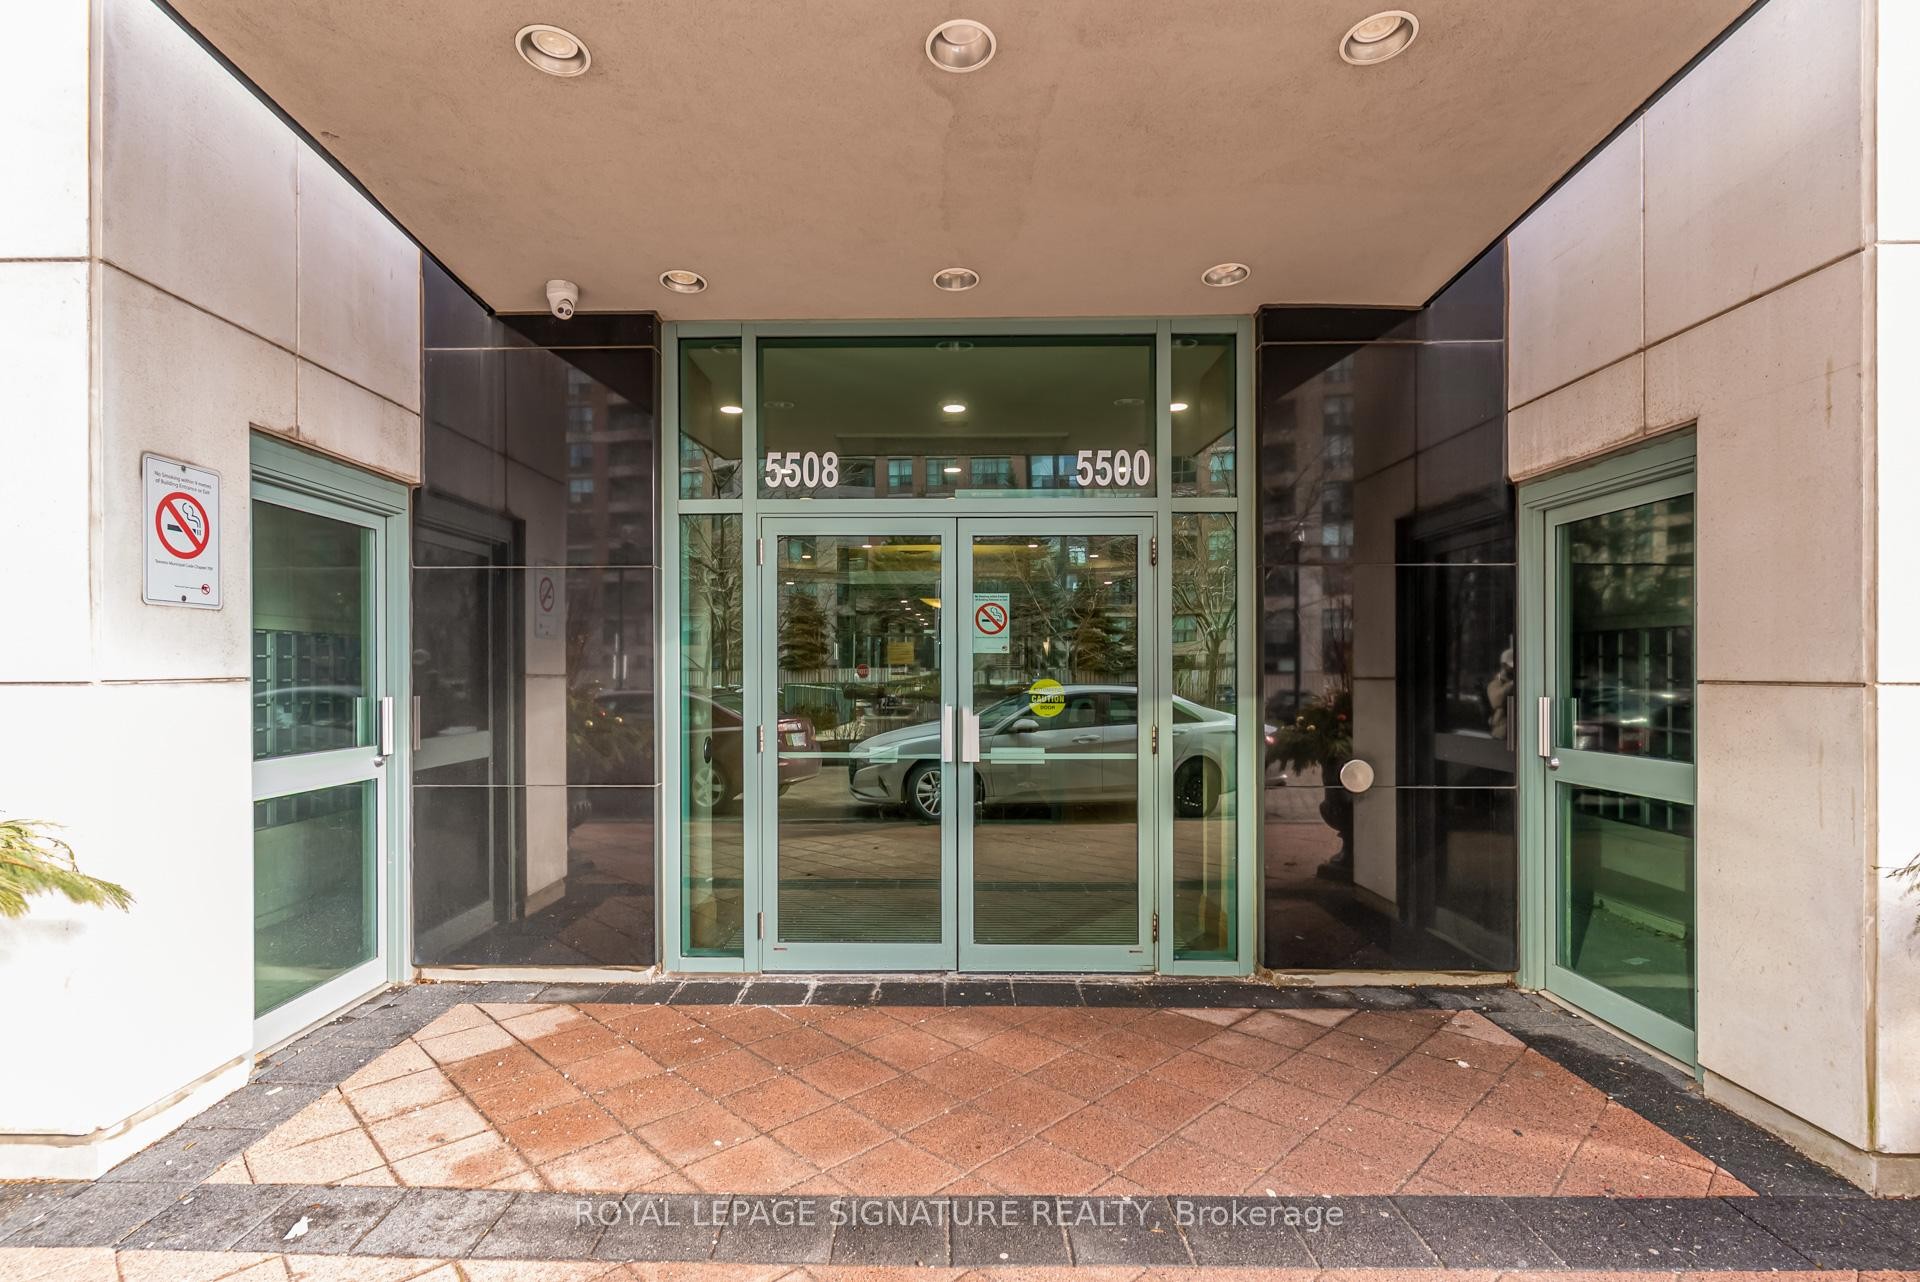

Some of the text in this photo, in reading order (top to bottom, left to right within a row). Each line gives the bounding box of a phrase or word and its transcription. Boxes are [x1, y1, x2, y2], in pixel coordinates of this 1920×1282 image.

[765, 452, 838, 488] 5508
[1076, 449, 1150, 486] 5500
[1031, 695, 1065, 703] CAUTION
